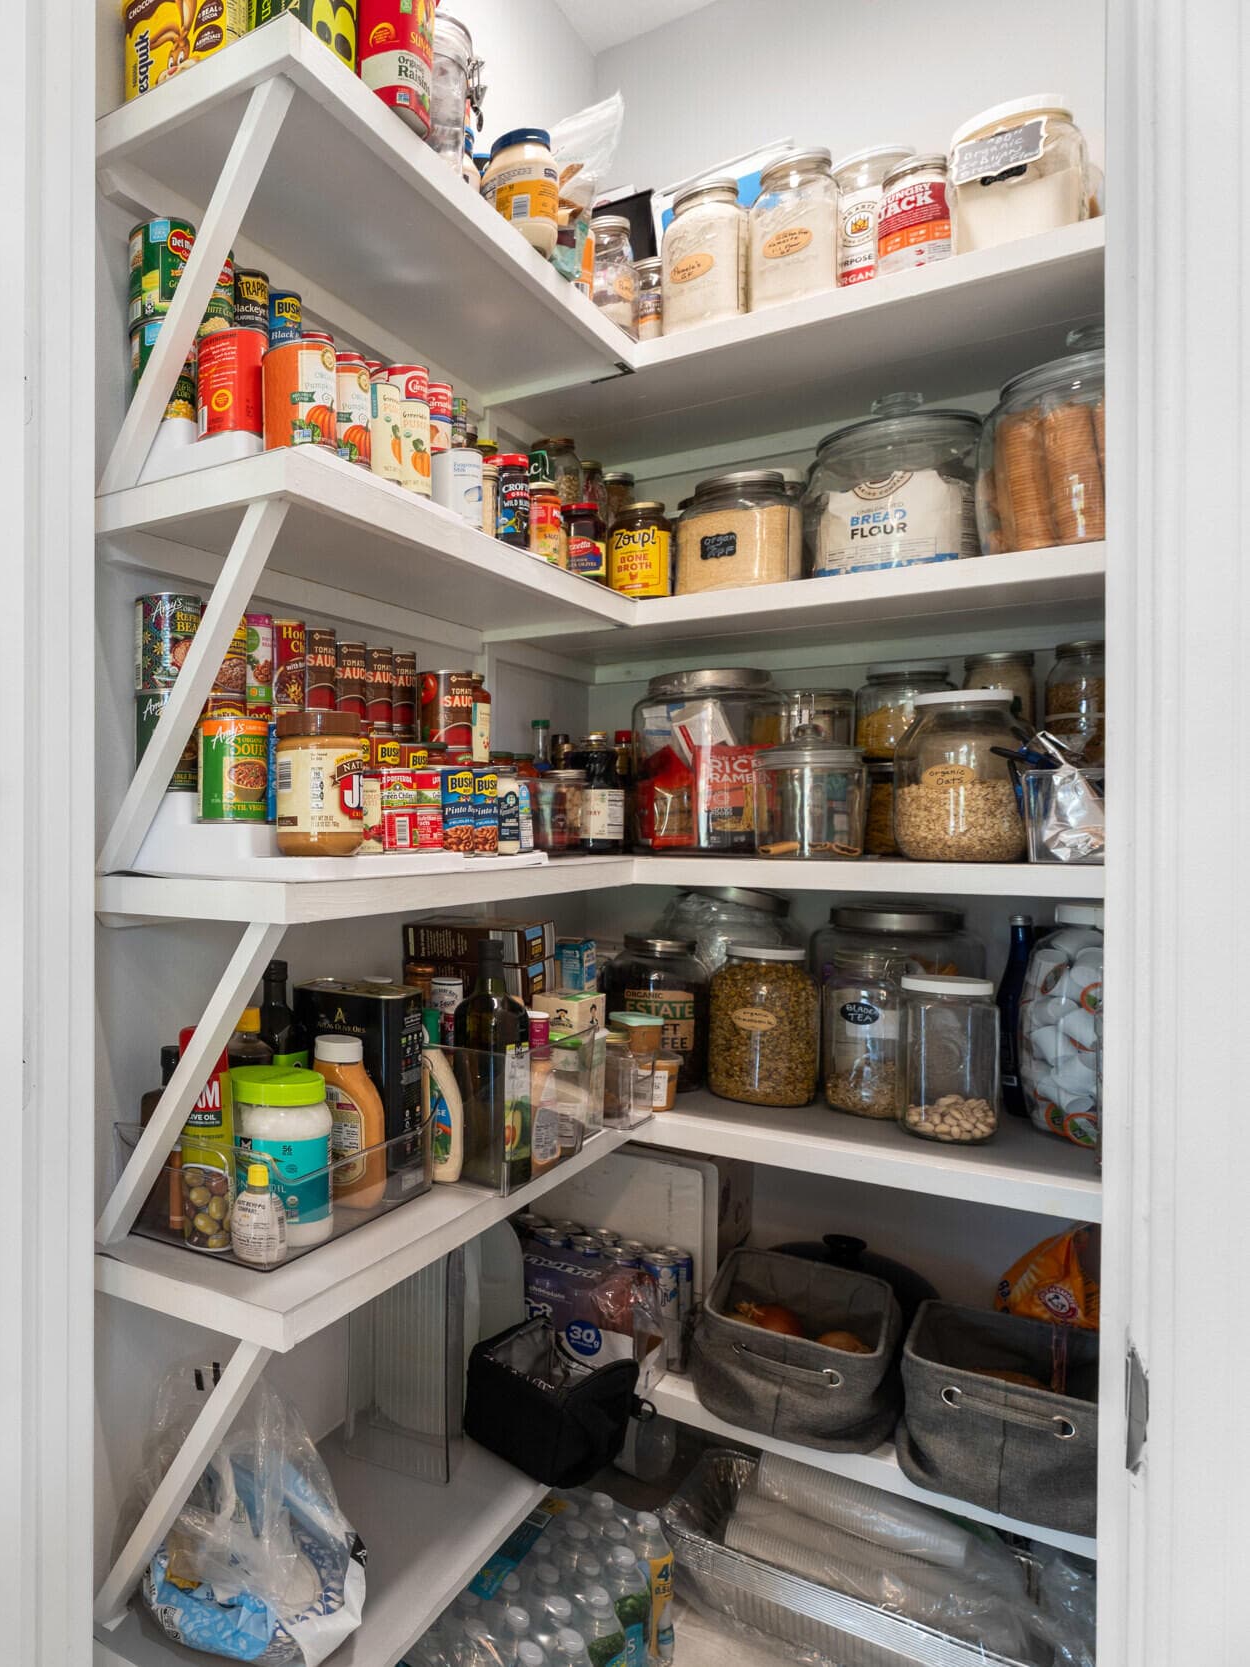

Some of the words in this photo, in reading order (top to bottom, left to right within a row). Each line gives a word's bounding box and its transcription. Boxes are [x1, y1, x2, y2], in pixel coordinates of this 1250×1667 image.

[128, 0, 150, 19] CHOCO
[201, 6, 219, 17] REAL
[135, 30, 154, 94] esquik
[878, 190, 935, 222] JACK
[271, 330, 295, 340] Black
[850, 508, 907, 527] BREAD
[851, 522, 908, 540] FLOUR
[614, 528, 657, 551] Zoup!
[619, 553, 649, 564] BONE
[617, 562, 652, 574] BROTH
[176, 622, 197, 632] BEA
[306, 655, 336, 668] SAUC
[335, 667, 366, 680] SAUC
[366, 671, 393, 684] SAUC
[392, 675, 416, 687] SAUC
[444, 695, 473, 707] SAUC
[710, 759, 767, 773] RICE
[929, 769, 965, 777] organic
[451, 778, 472, 790] BUSH
[936, 777, 964, 786] Oats
[445, 805, 467, 815] Pinto
[625, 990, 664, 1000] ORGANIC
[625, 1000, 695, 1019] ESTATE
[849, 1013, 873, 1023] TEA
[661, 1036, 688, 1049] FEE
[282, 1145, 293, 1153] 56
